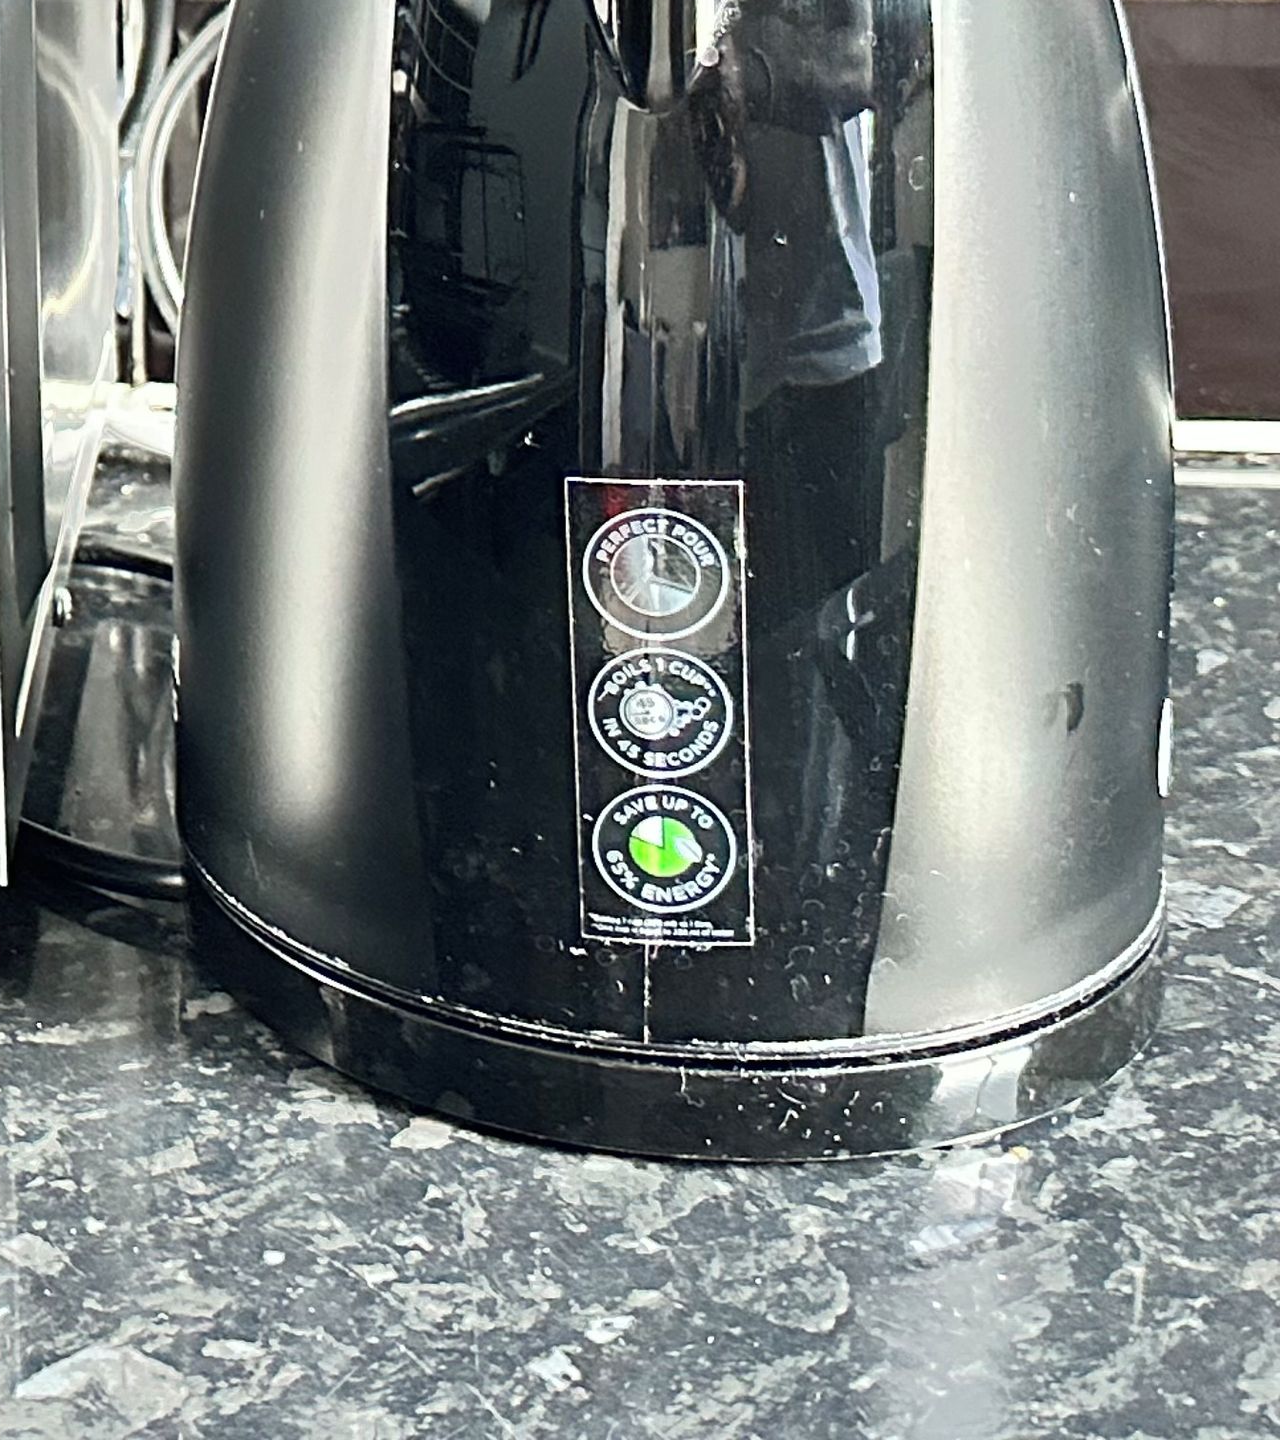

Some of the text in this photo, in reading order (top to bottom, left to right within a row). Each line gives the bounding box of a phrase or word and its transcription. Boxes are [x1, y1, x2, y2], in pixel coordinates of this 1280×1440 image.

[596, 519, 715, 567] PERFECT POUR
[603, 718, 719, 767] IN 45 SECONDS
[613, 795, 713, 829] SAVE UP TO
